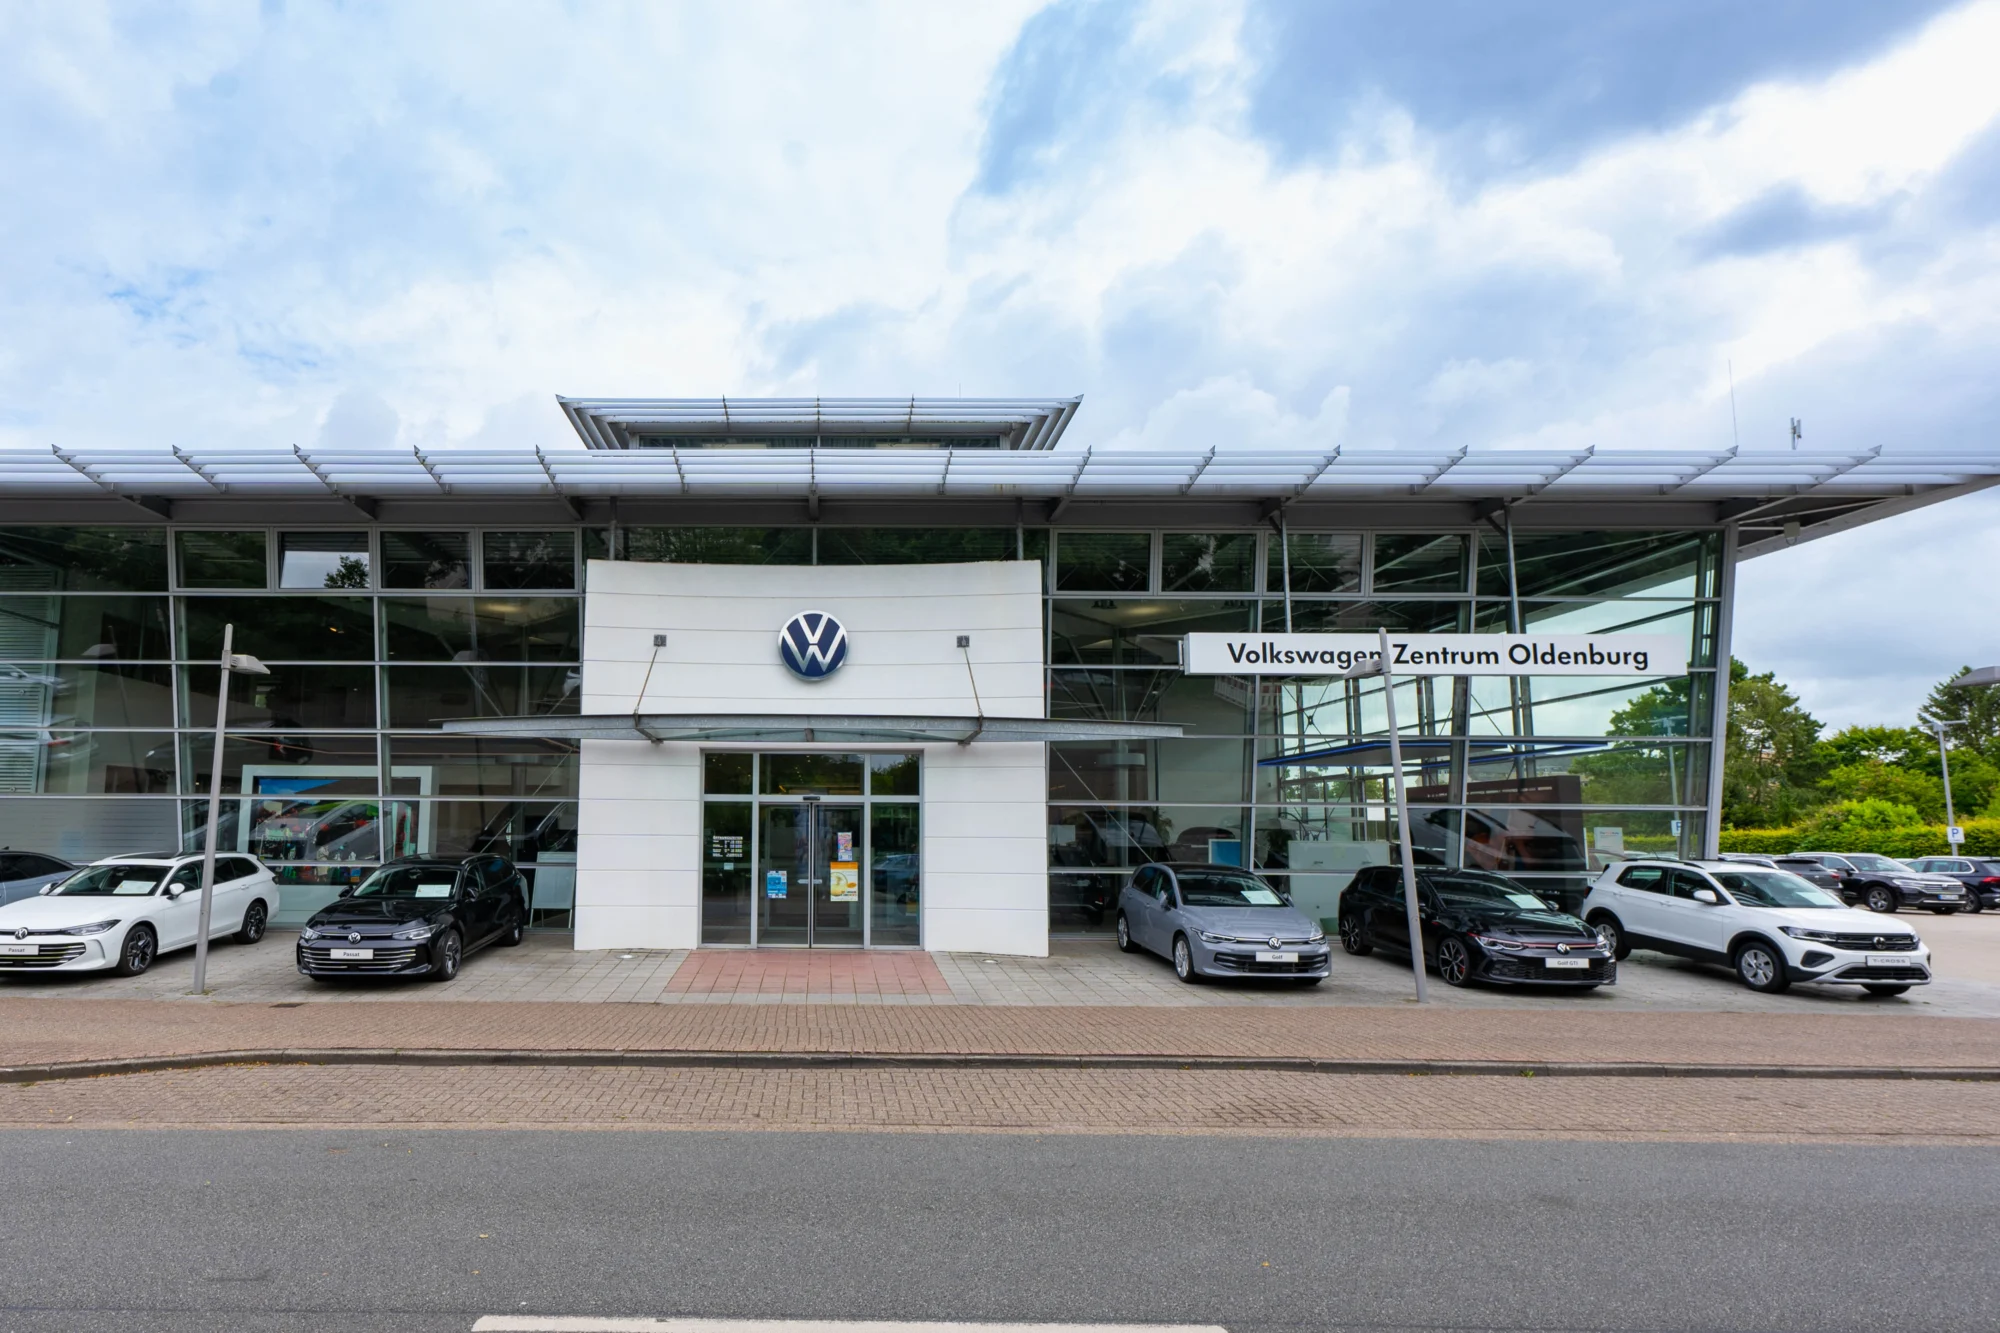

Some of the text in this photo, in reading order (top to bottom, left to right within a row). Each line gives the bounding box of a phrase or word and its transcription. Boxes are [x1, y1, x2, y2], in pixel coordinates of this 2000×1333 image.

[1392, 643, 1499, 665] Zentrum
[1508, 642, 1649, 671] Oldenburg
[1951, 828, 1959, 838] P
